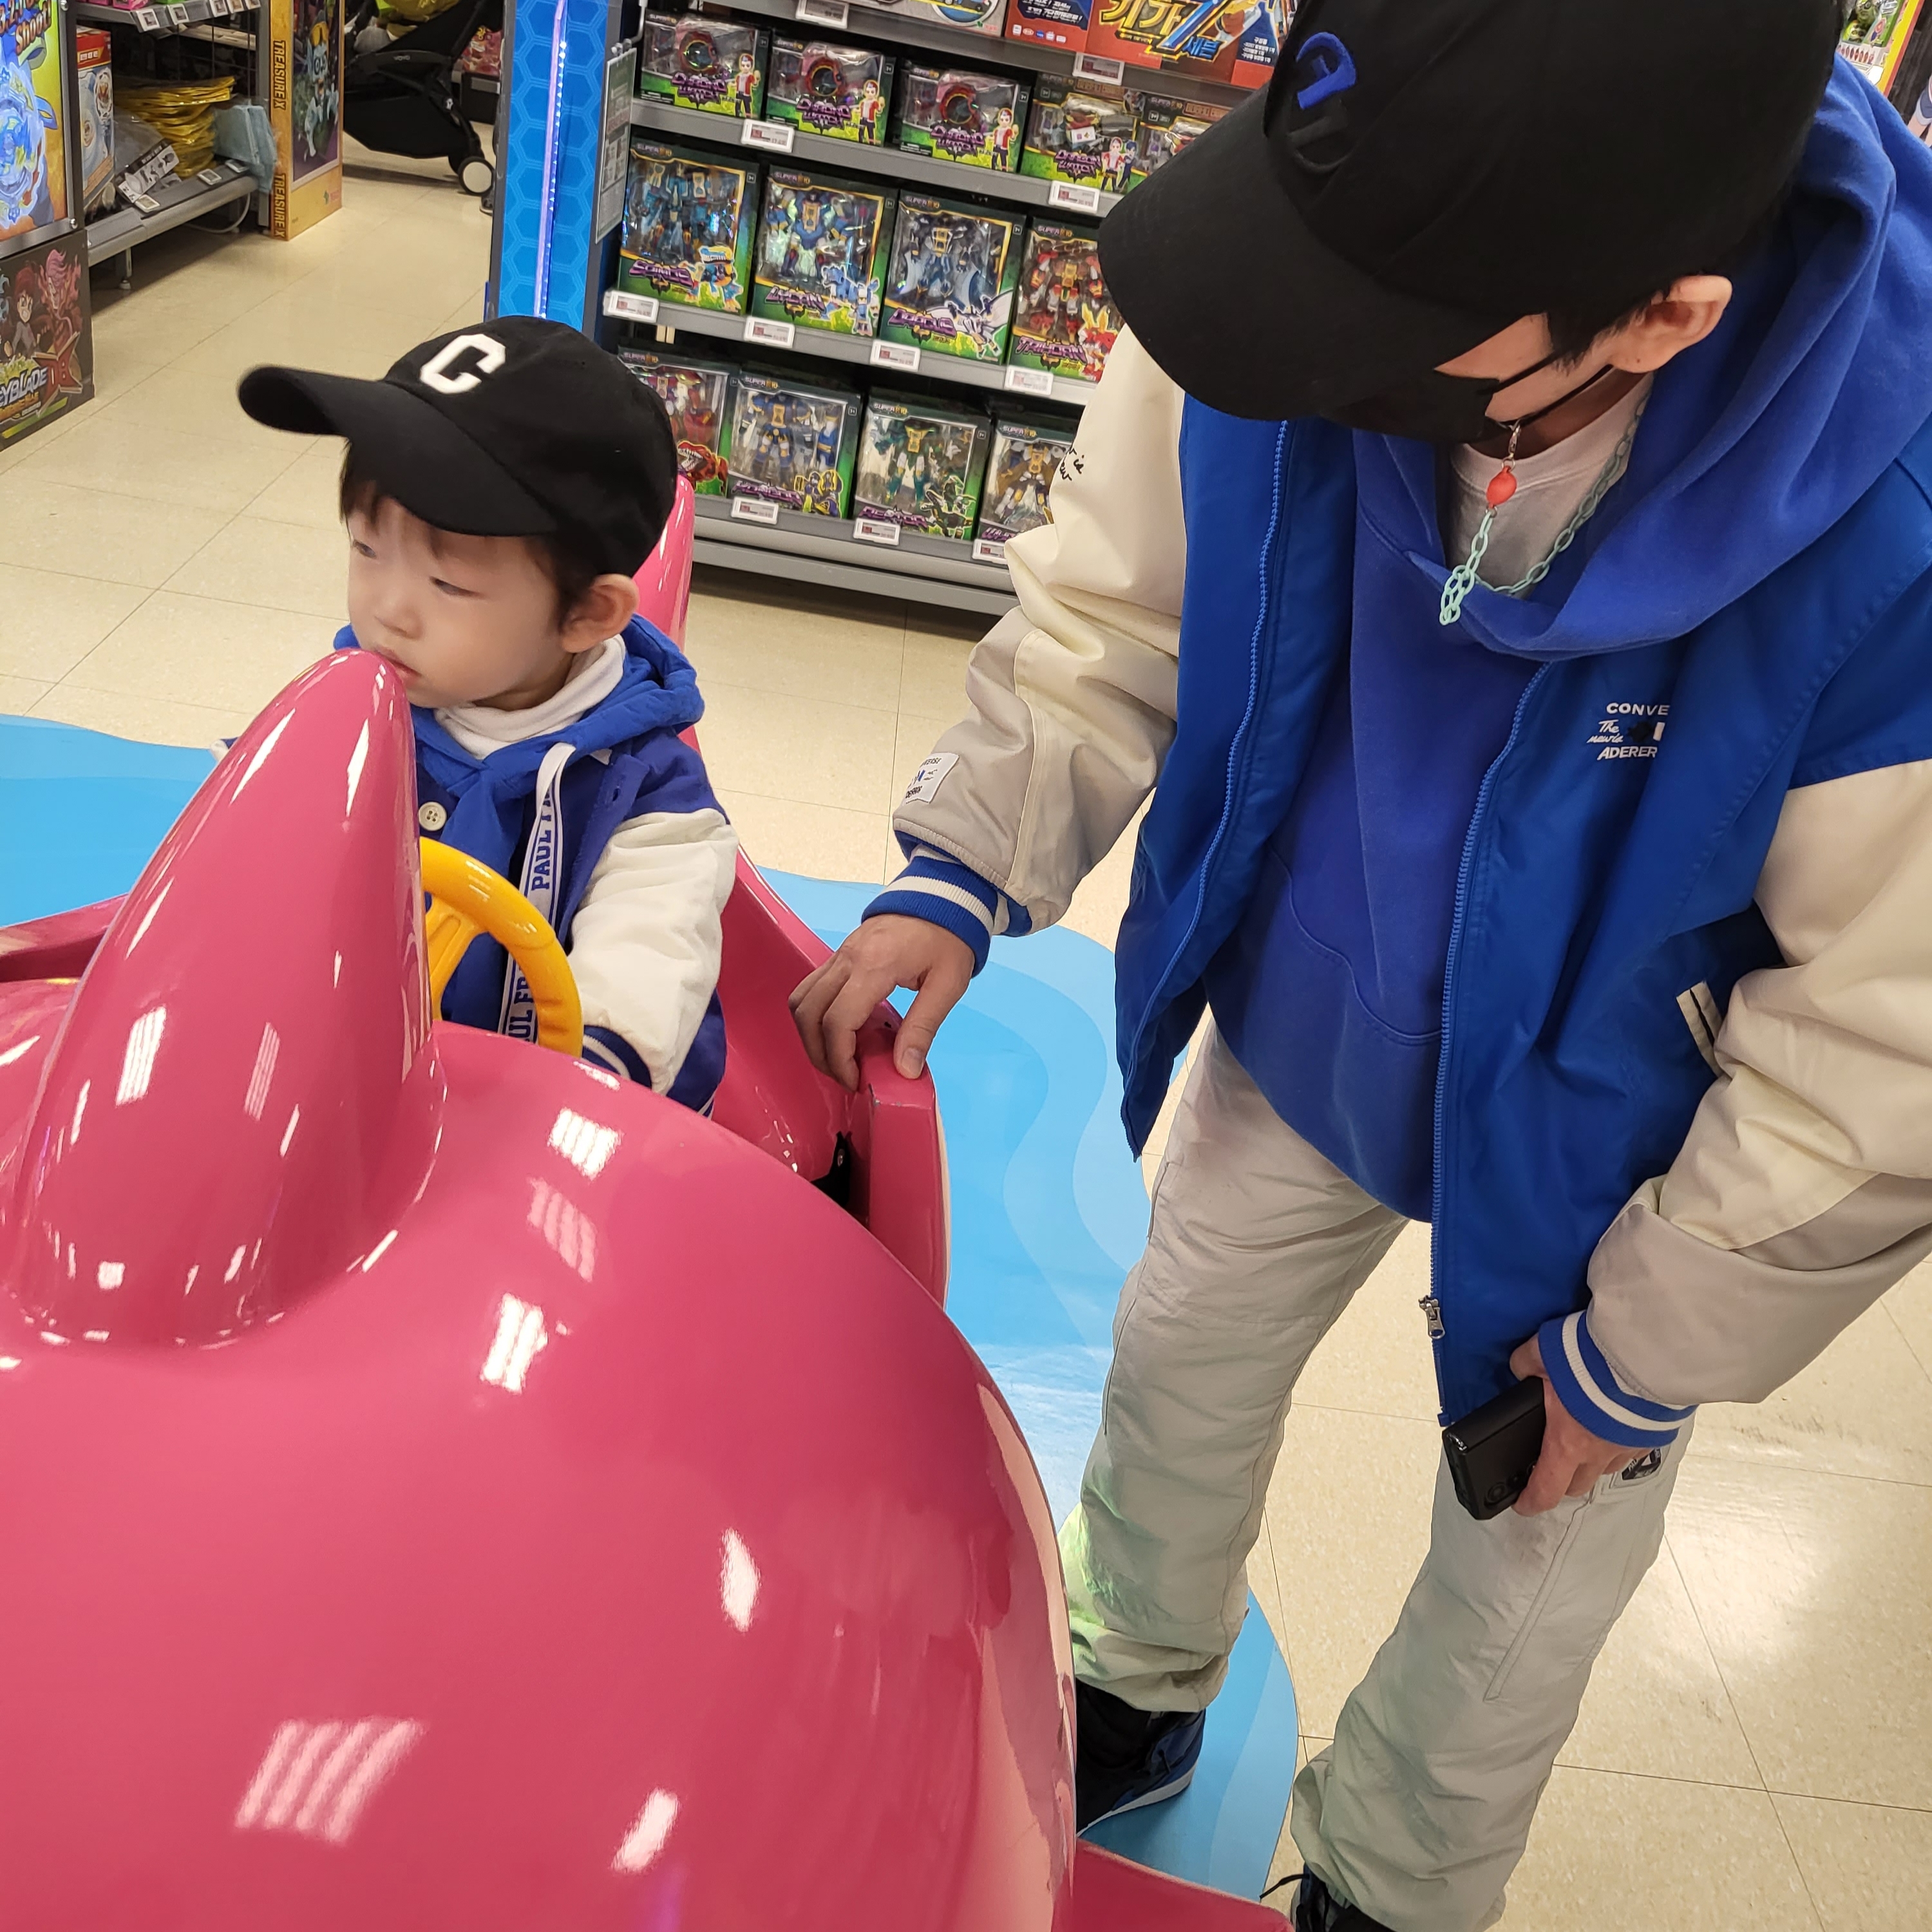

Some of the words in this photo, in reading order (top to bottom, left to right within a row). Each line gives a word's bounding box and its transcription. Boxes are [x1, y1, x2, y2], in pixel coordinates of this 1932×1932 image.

[274, 40, 286, 98] TREASURE
[274, 98, 286, 110] X
[274, 174, 285, 227] TREASURE
[275, 227, 285, 238] X
[420, 334, 506, 394] C
[1598, 719, 1620, 734] The
[531, 830, 552, 891] PAUL
